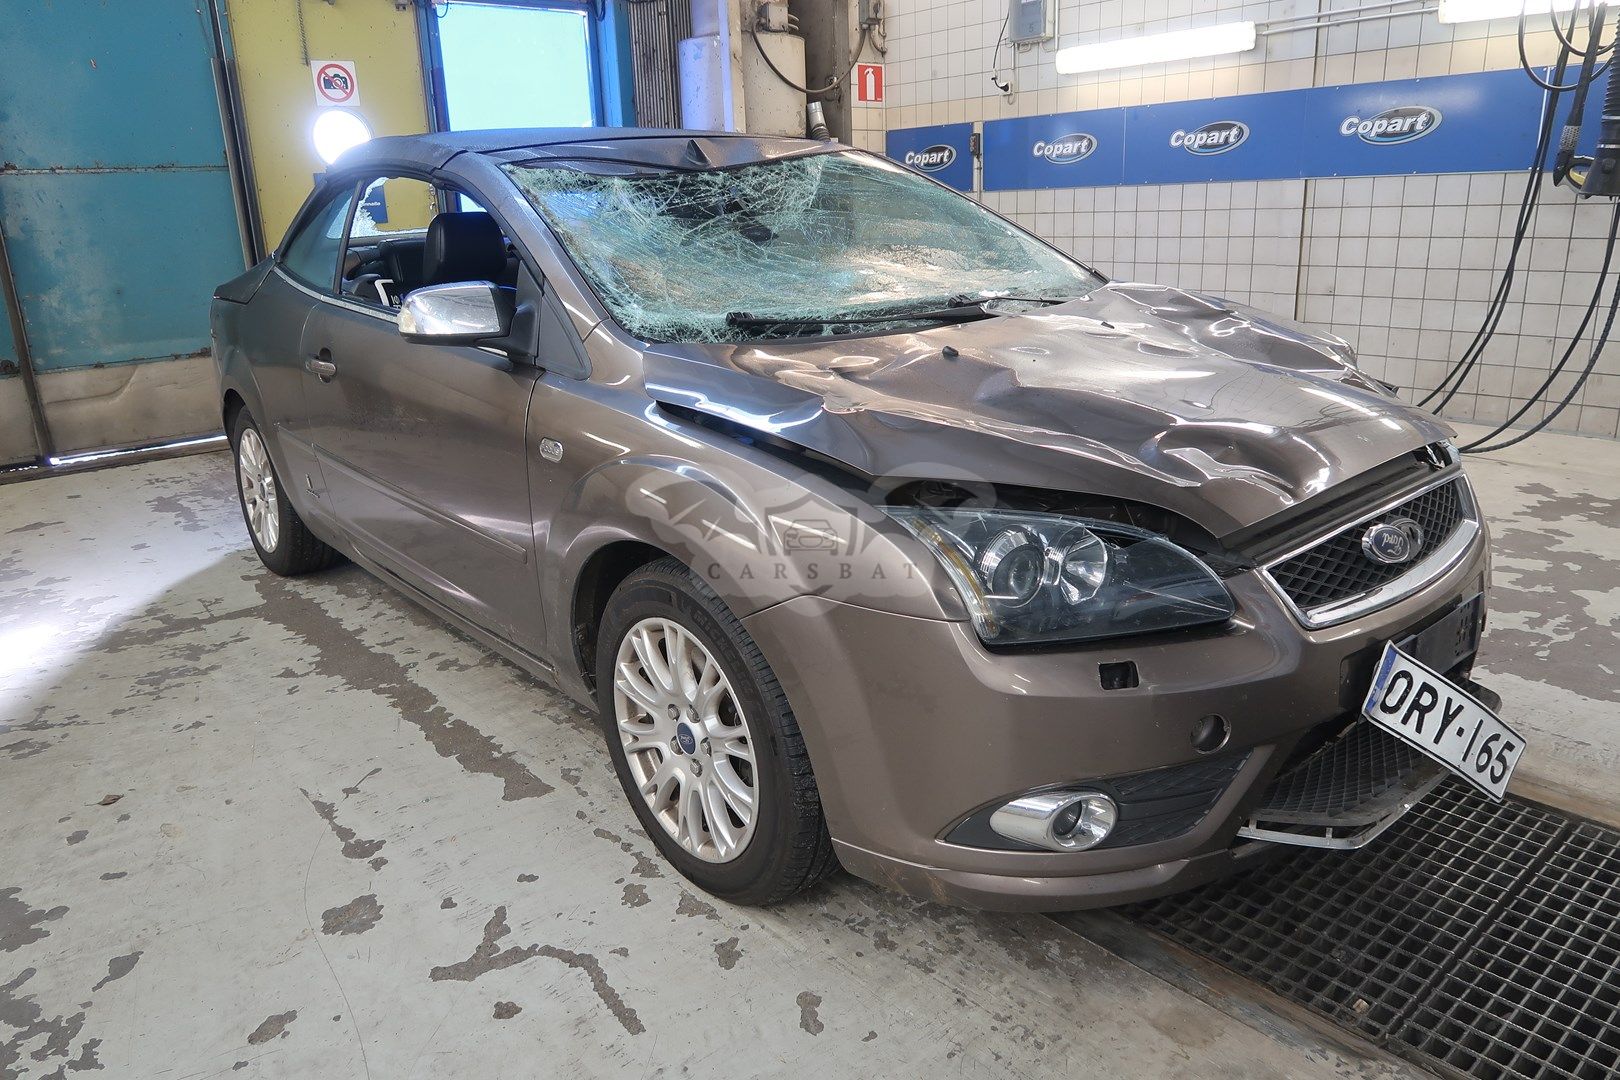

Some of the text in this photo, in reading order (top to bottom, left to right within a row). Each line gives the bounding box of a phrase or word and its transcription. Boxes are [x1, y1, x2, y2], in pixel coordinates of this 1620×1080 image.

[1340, 110, 1430, 138] Copart
[1033, 137, 1090, 157] Copart
[1170, 125, 1241, 148] Copart
[905, 148, 950, 168] Copart
[1381, 532, 1404, 556] Ford
